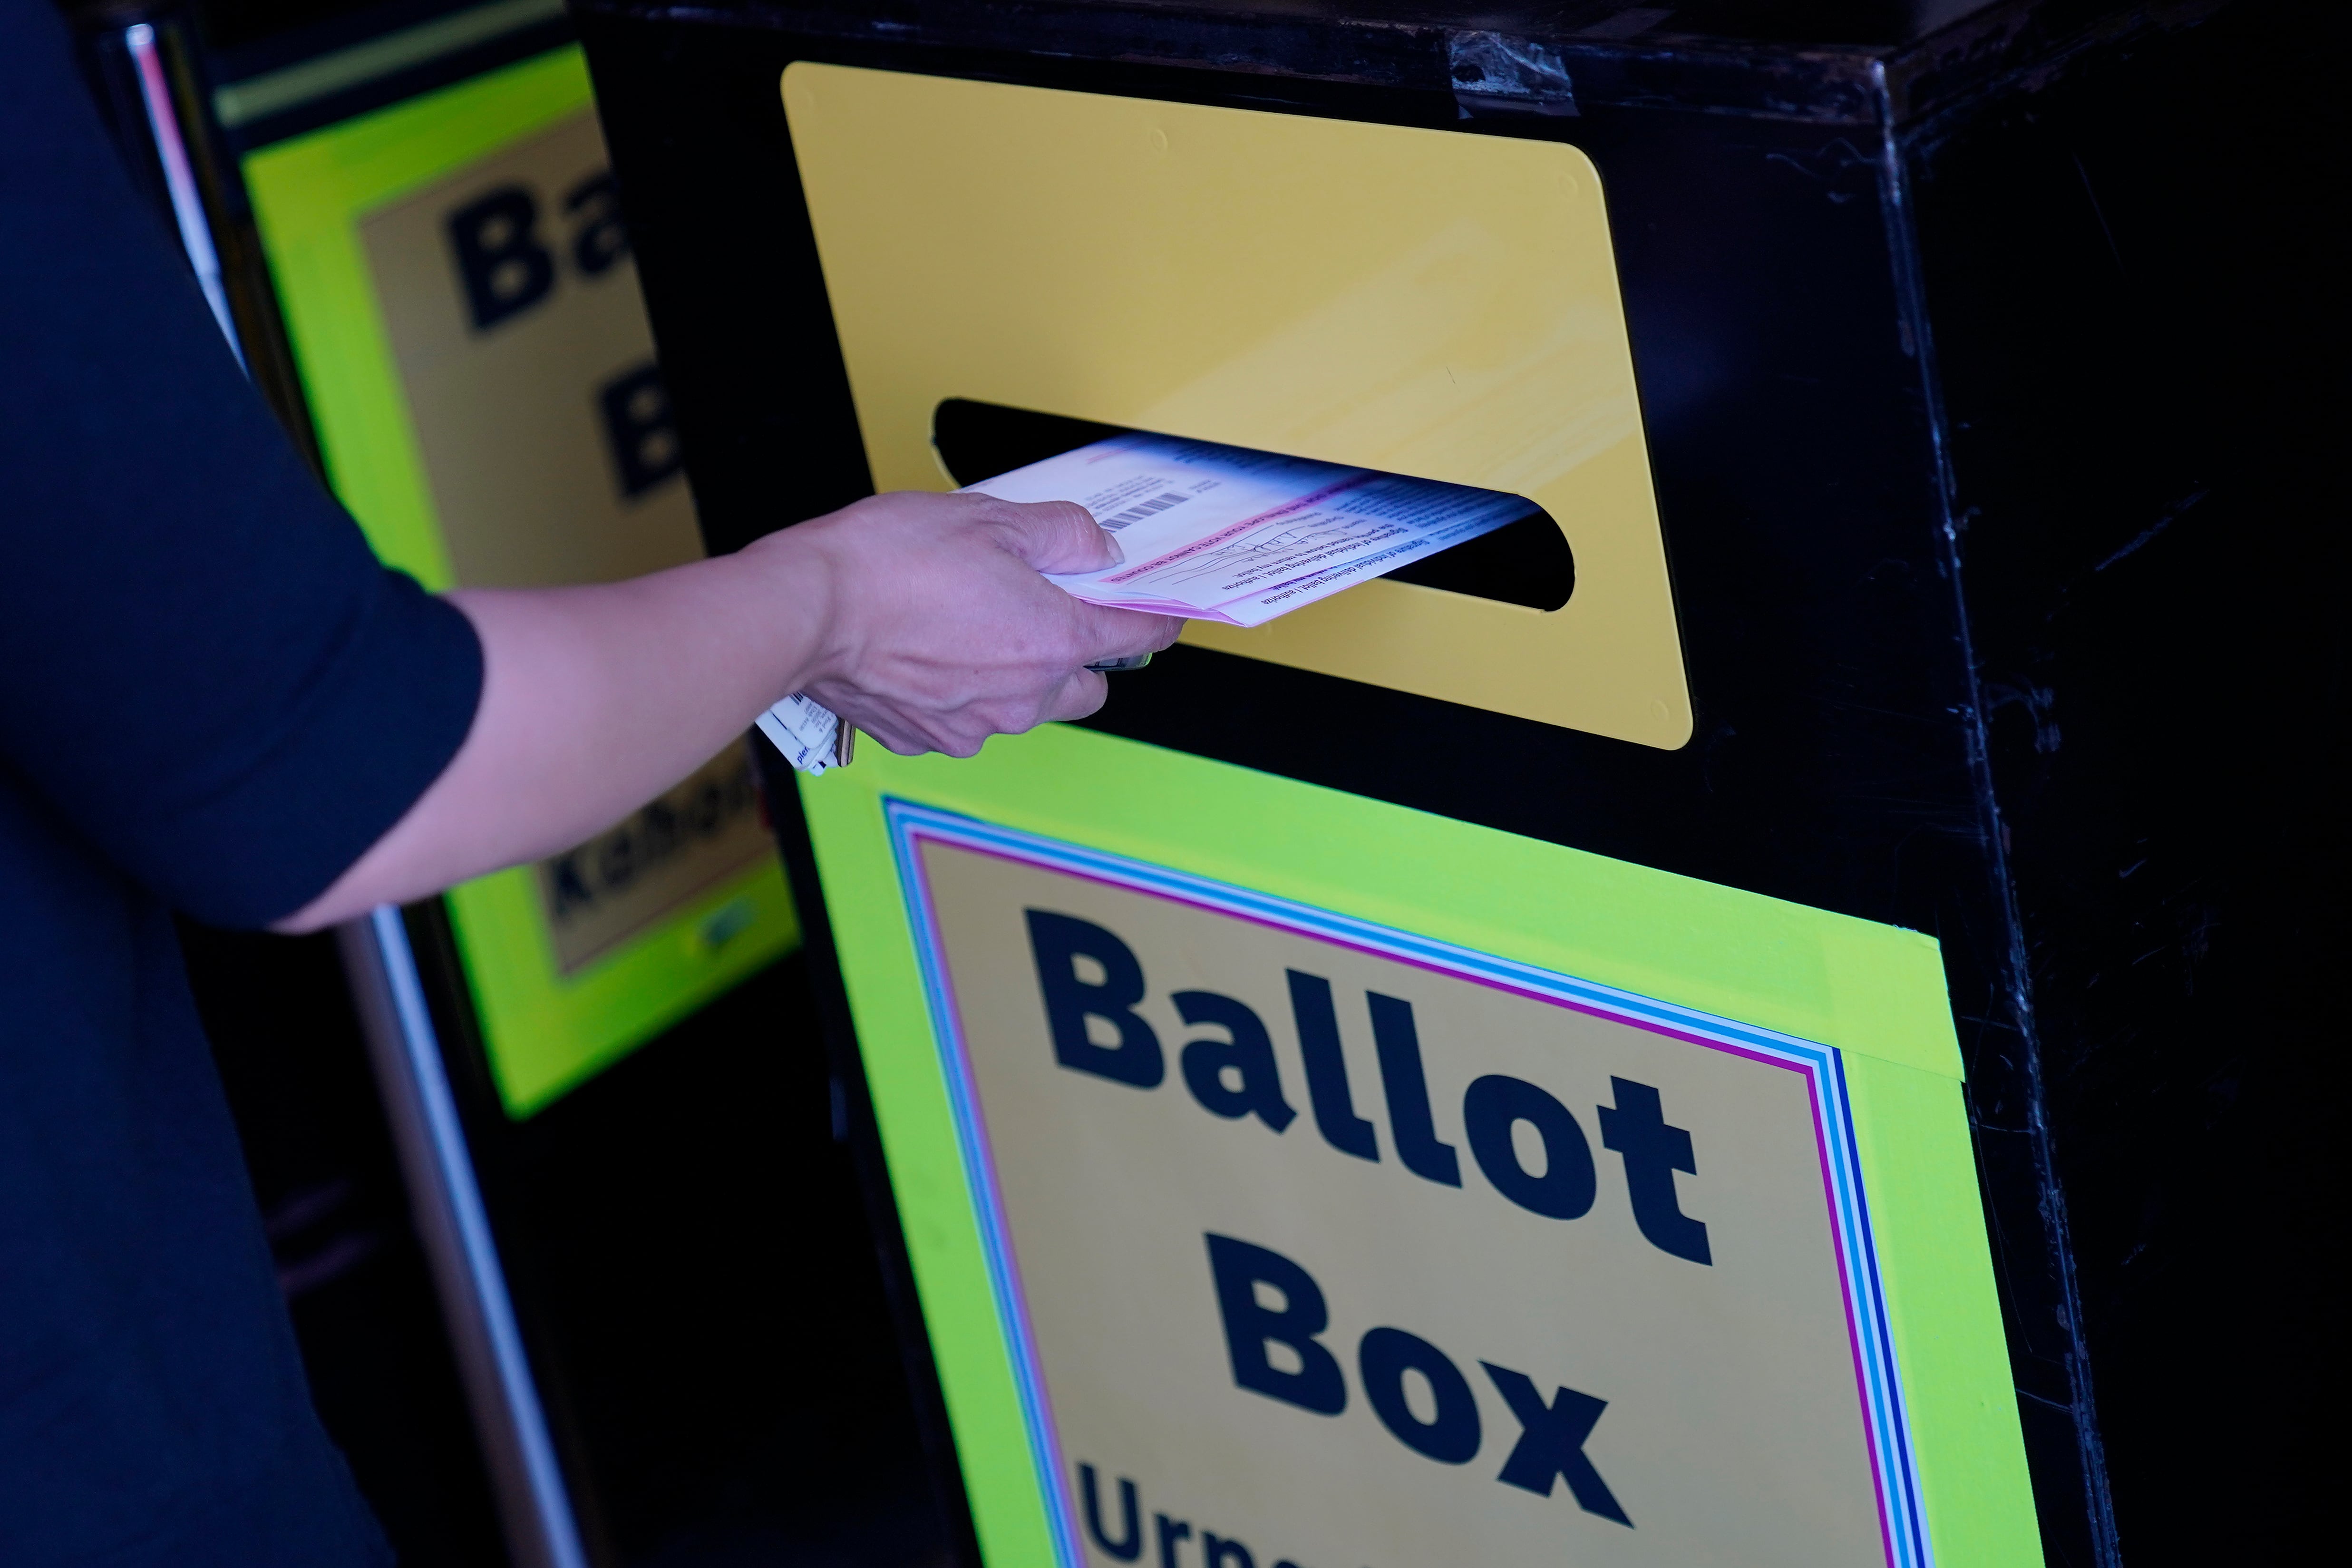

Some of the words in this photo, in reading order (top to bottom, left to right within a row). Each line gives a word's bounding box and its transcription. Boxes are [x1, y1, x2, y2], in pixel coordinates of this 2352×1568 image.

[1325, 542, 1365, 557] individual
[1285, 553, 1327, 569] delivering
[1354, 553, 1388, 570] individual
[1318, 566, 1357, 582] delivering
[1222, 576, 1260, 590] authorize
[1261, 589, 1296, 604] authorize
[1022, 906, 1713, 1267] Ballot
[1203, 1229, 1636, 1529] Box
[1076, 1459, 1305, 1568] Urn
